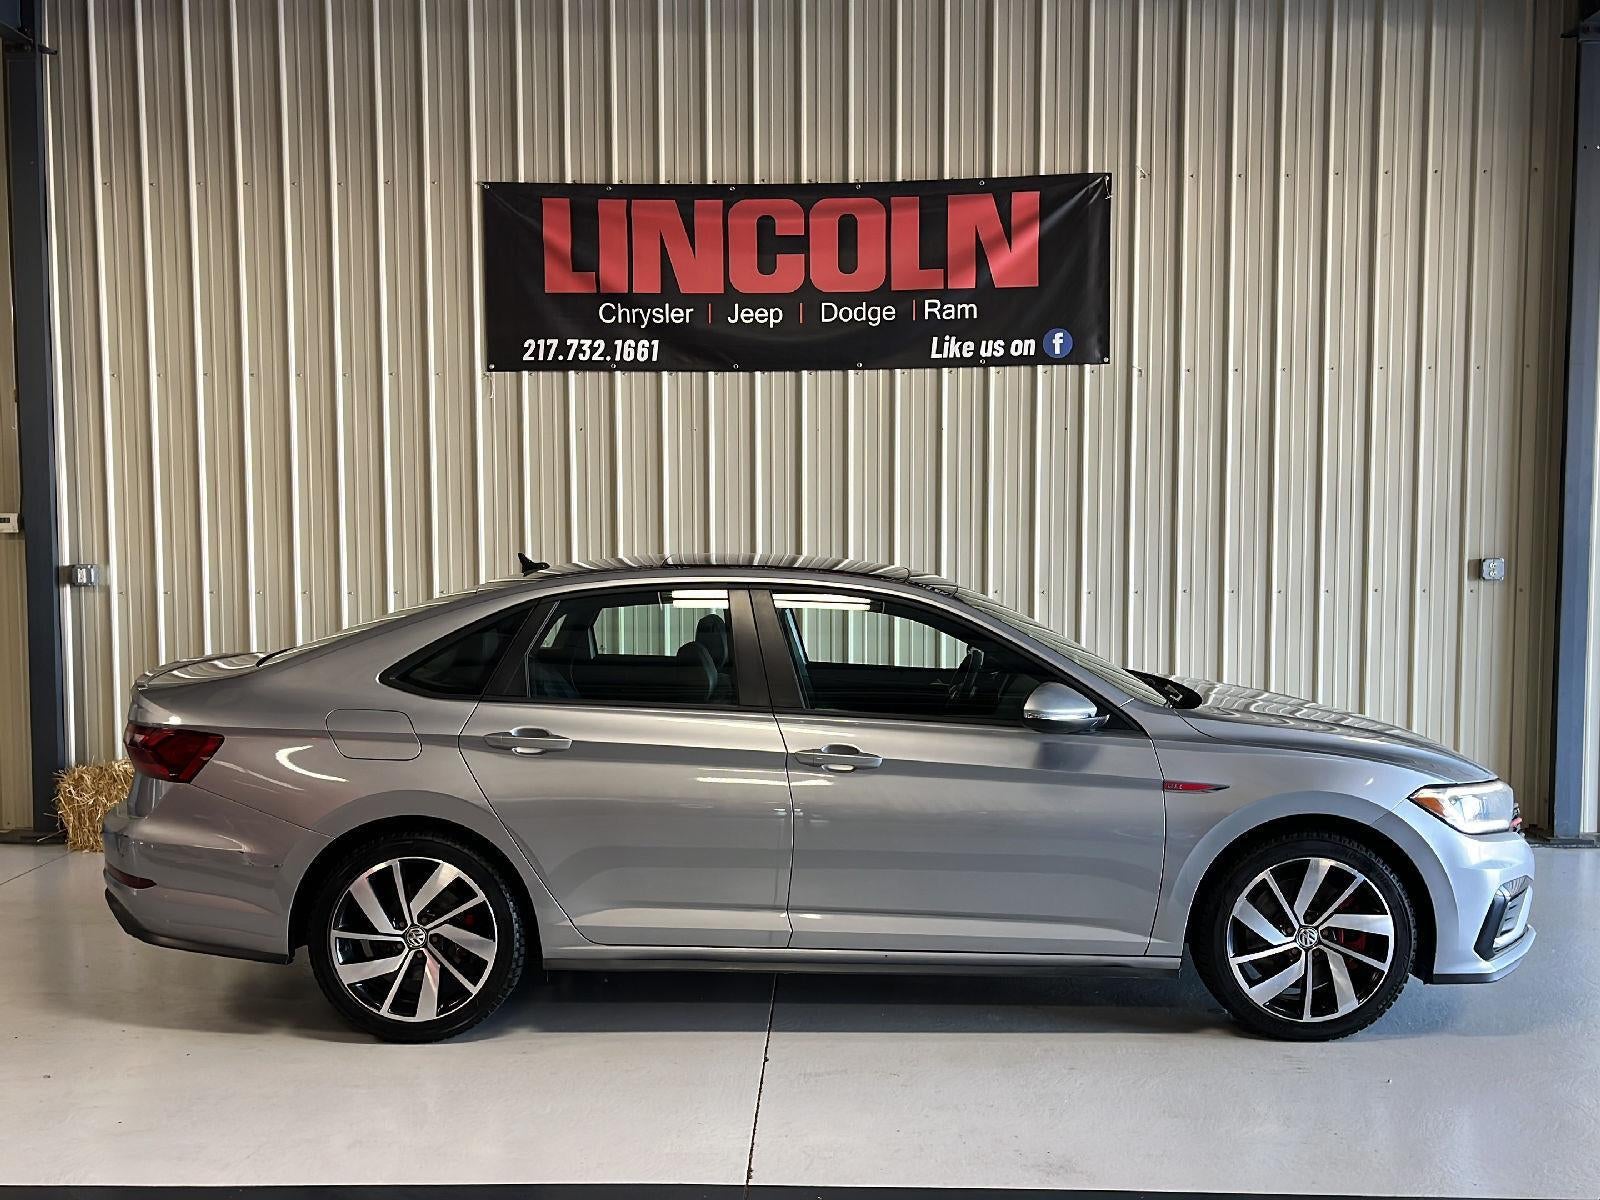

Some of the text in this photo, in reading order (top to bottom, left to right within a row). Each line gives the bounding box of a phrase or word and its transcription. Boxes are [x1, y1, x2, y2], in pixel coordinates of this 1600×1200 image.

[543, 191, 1040, 294] LINCOLN
[599, 300, 978, 328] Chrysler Jeep Dodge Ram
[522, 339, 660, 361] 217.732.1661
[931, 335, 975, 358] Like
[980, 340, 1005, 357] us
[1010, 338, 1036, 356] on
